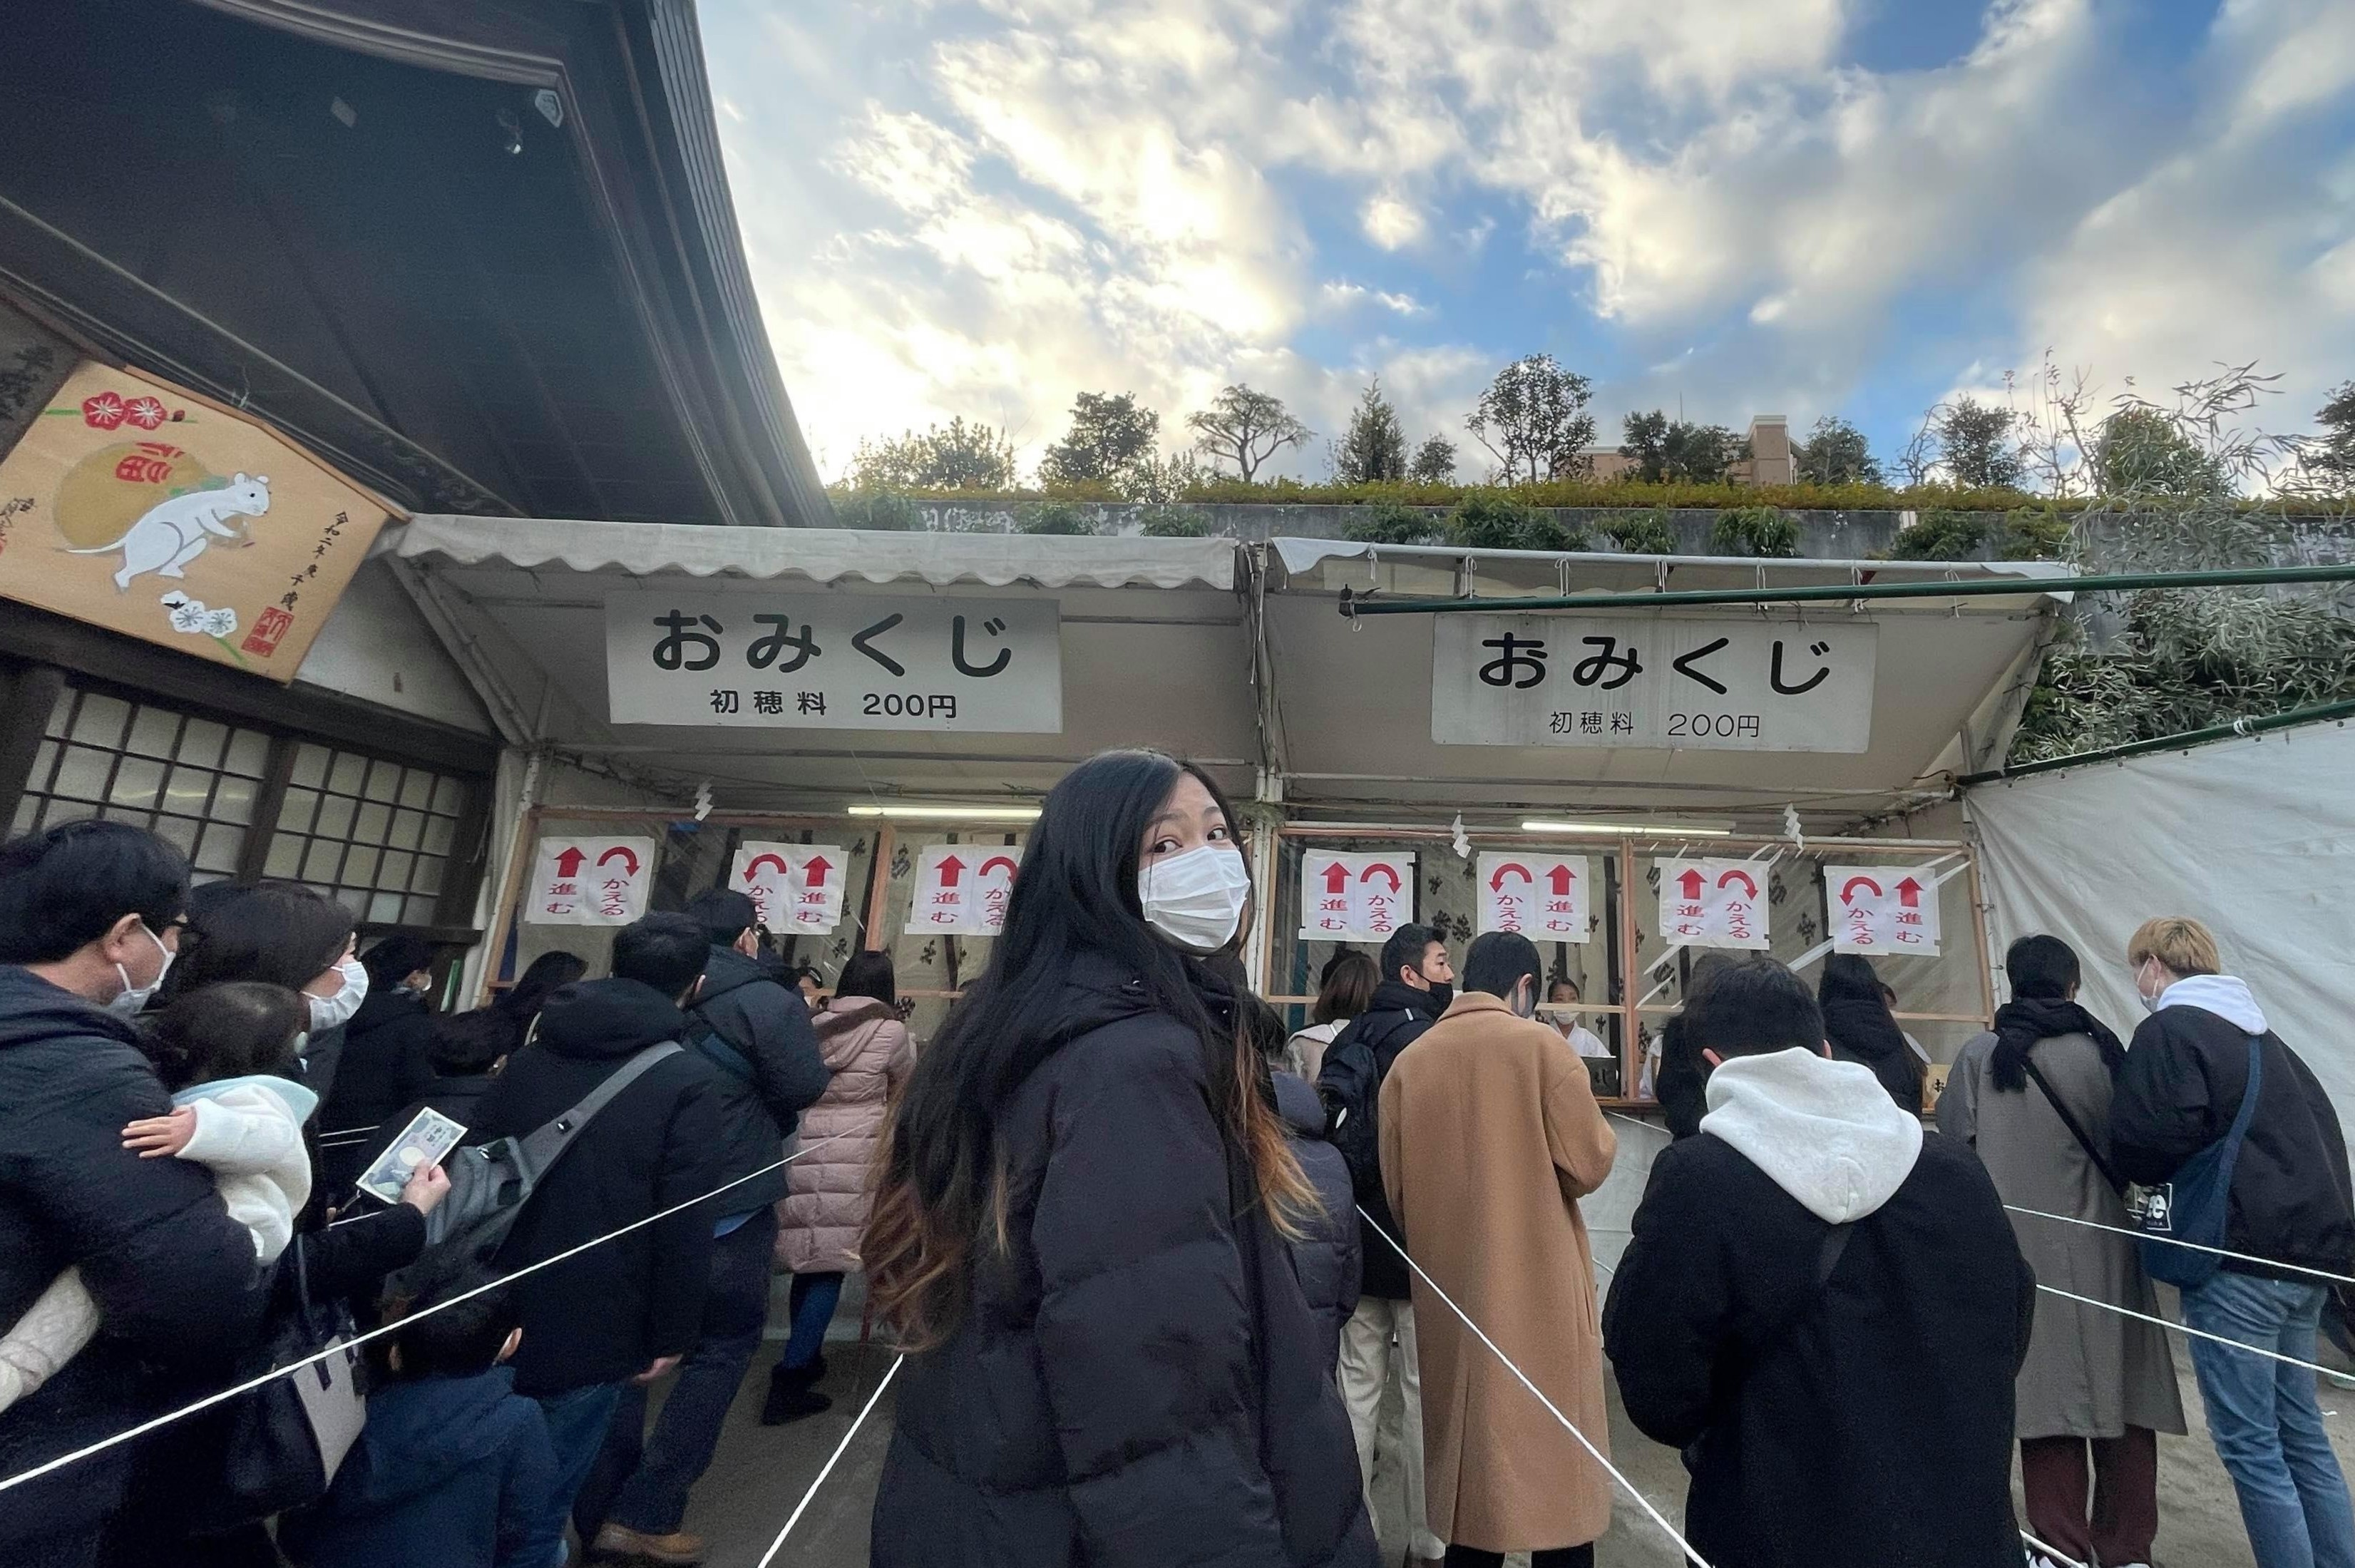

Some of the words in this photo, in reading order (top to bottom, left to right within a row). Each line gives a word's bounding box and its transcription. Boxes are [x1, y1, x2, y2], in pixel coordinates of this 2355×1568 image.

[652, 609, 1012, 677] おみくじ
[1479, 632, 1830, 695] おみくじ
[710, 689, 826, 716] 初穂料
[862, 693, 957, 718] 200円
[1549, 710, 1634, 736] 初穂料
[1667, 713, 1759, 739] 200円
[547, 883, 577, 914] 進む
[600, 878, 629, 916] かえる
[796, 892, 826, 923] 進む
[931, 892, 960, 923] 進む
[985, 888, 1009, 926] かえる
[1497, 895, 1523, 931] かえる
[1320, 898, 1348, 930] 進む
[1368, 895, 1394, 932] かえる
[1546, 901, 1573, 931] 進む
[1677, 905, 1704, 936] 進む
[1726, 901, 1752, 938] かえる
[1848, 908, 1874, 945] かえる
[1895, 912, 1923, 943] 進む
